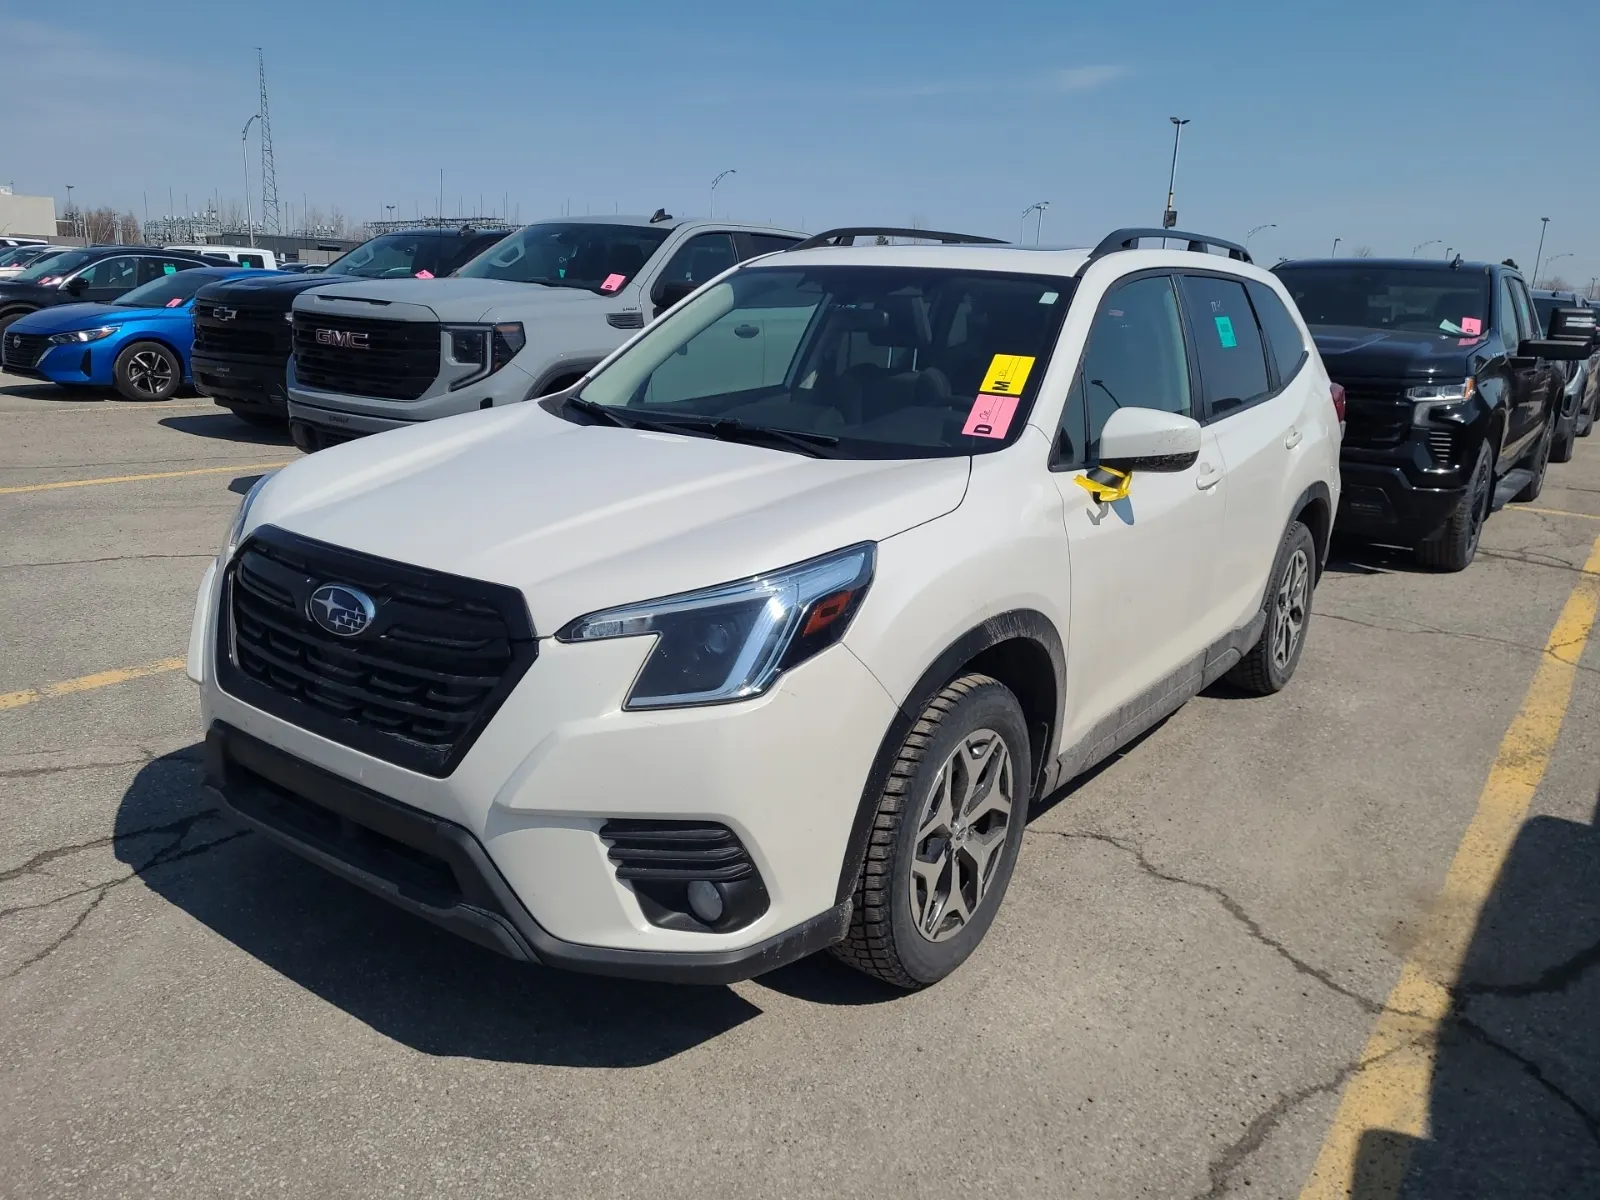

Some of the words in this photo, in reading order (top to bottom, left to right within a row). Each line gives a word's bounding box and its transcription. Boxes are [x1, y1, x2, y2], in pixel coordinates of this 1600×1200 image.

[315, 328, 370, 349] GMC
[992, 381, 1011, 391] M
[973, 424, 993, 435] D
